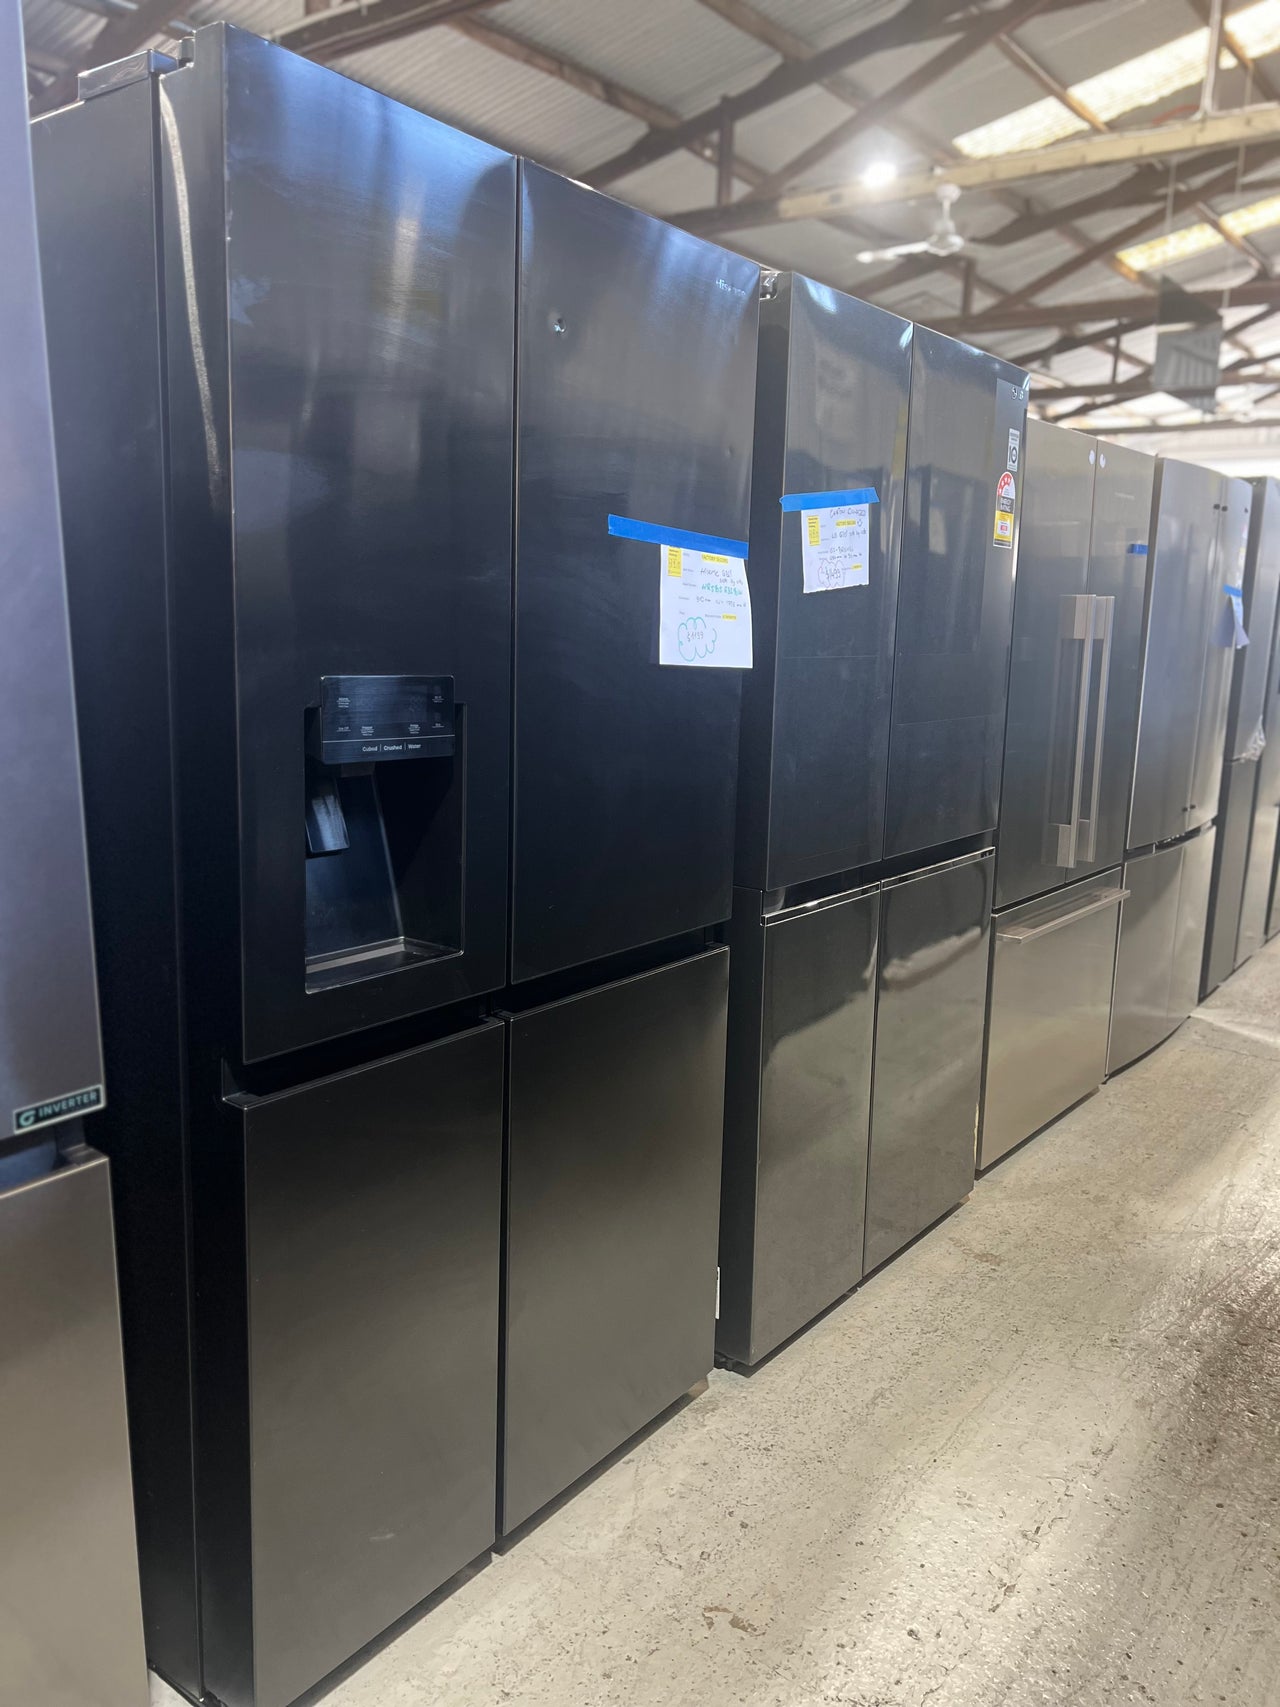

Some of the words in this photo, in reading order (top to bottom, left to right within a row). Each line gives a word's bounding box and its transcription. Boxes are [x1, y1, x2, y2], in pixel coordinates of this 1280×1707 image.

[362, 745, 378, 753] Cubed
[383, 743, 403, 752] Crushed
[407, 742, 422, 750] Water
[37, 1089, 98, 1118] INVERTER
